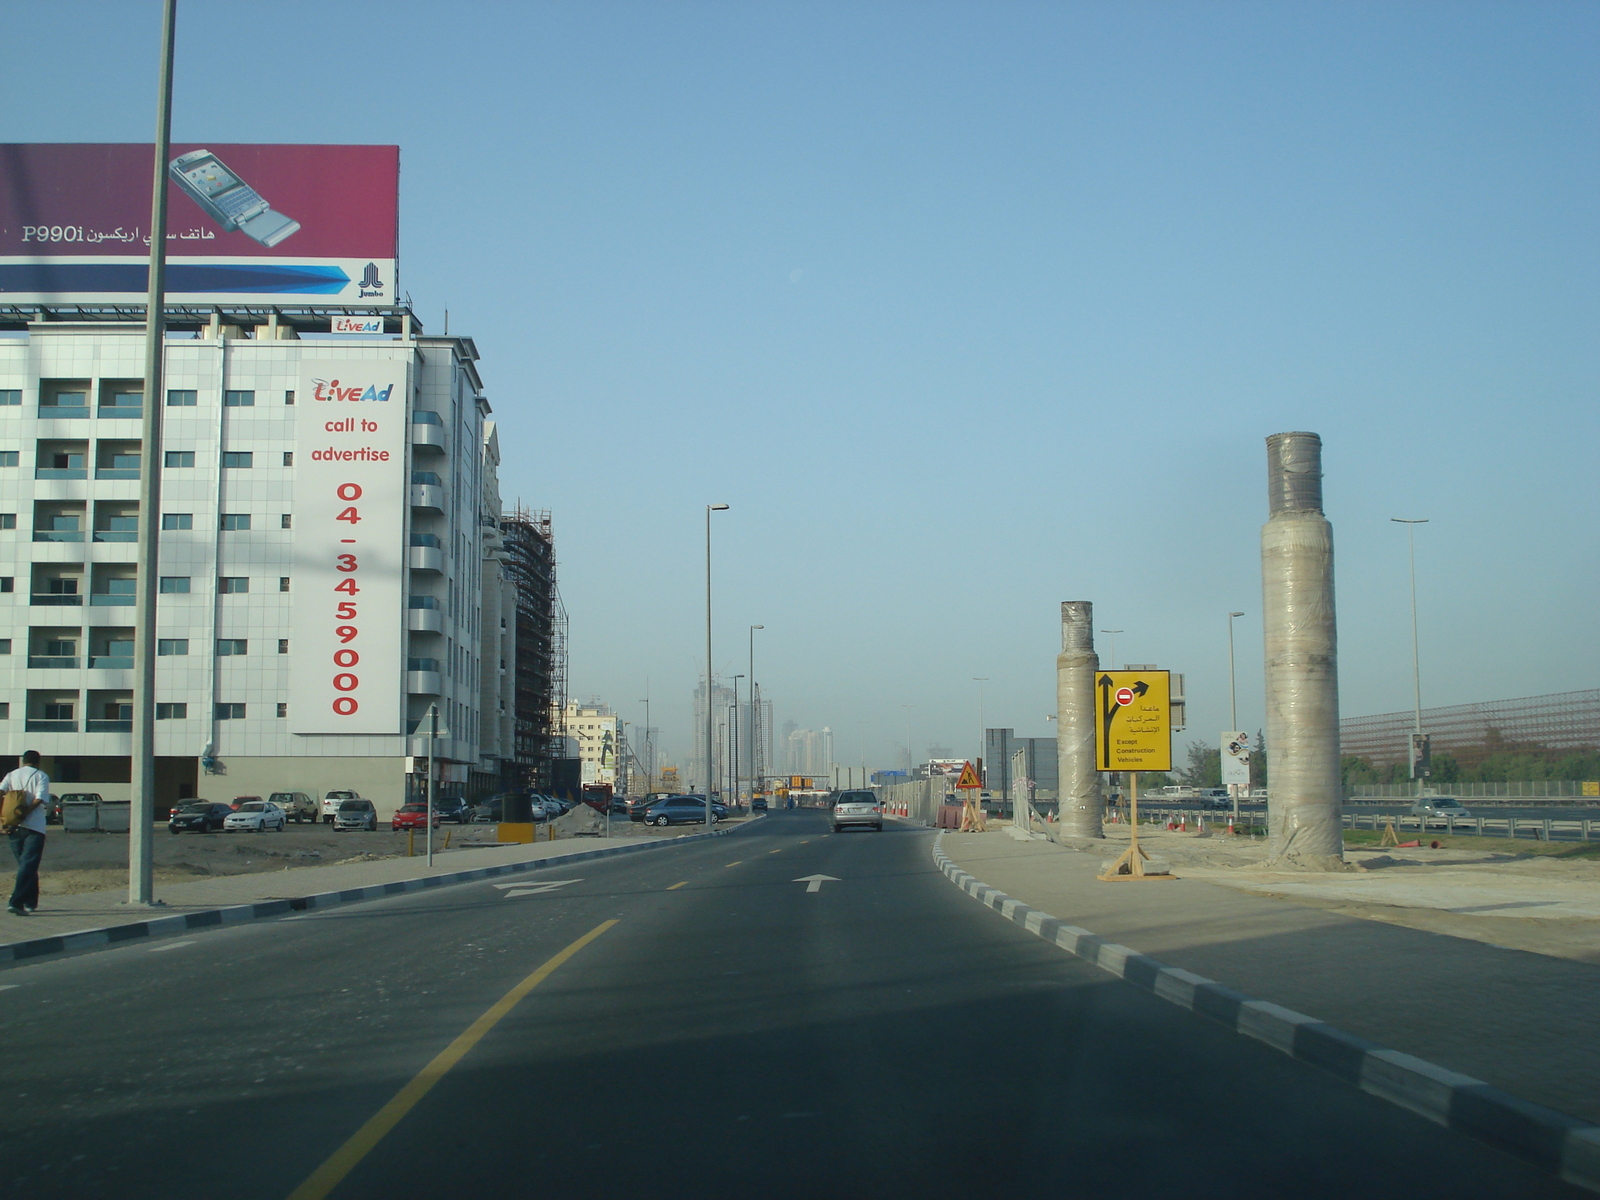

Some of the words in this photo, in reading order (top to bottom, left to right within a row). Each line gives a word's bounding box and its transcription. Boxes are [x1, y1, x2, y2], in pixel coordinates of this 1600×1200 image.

[22, 225, 84, 242] P990i
[87, 227, 139, 243] اريكسون
[143, 233, 177, 246] سي
[180, 226, 215, 239] هاتف
[358, 289, 384, 298] Jumbo
[325, 418, 355, 432] call
[361, 419, 378, 432] to
[311, 446, 390, 462] advertise
